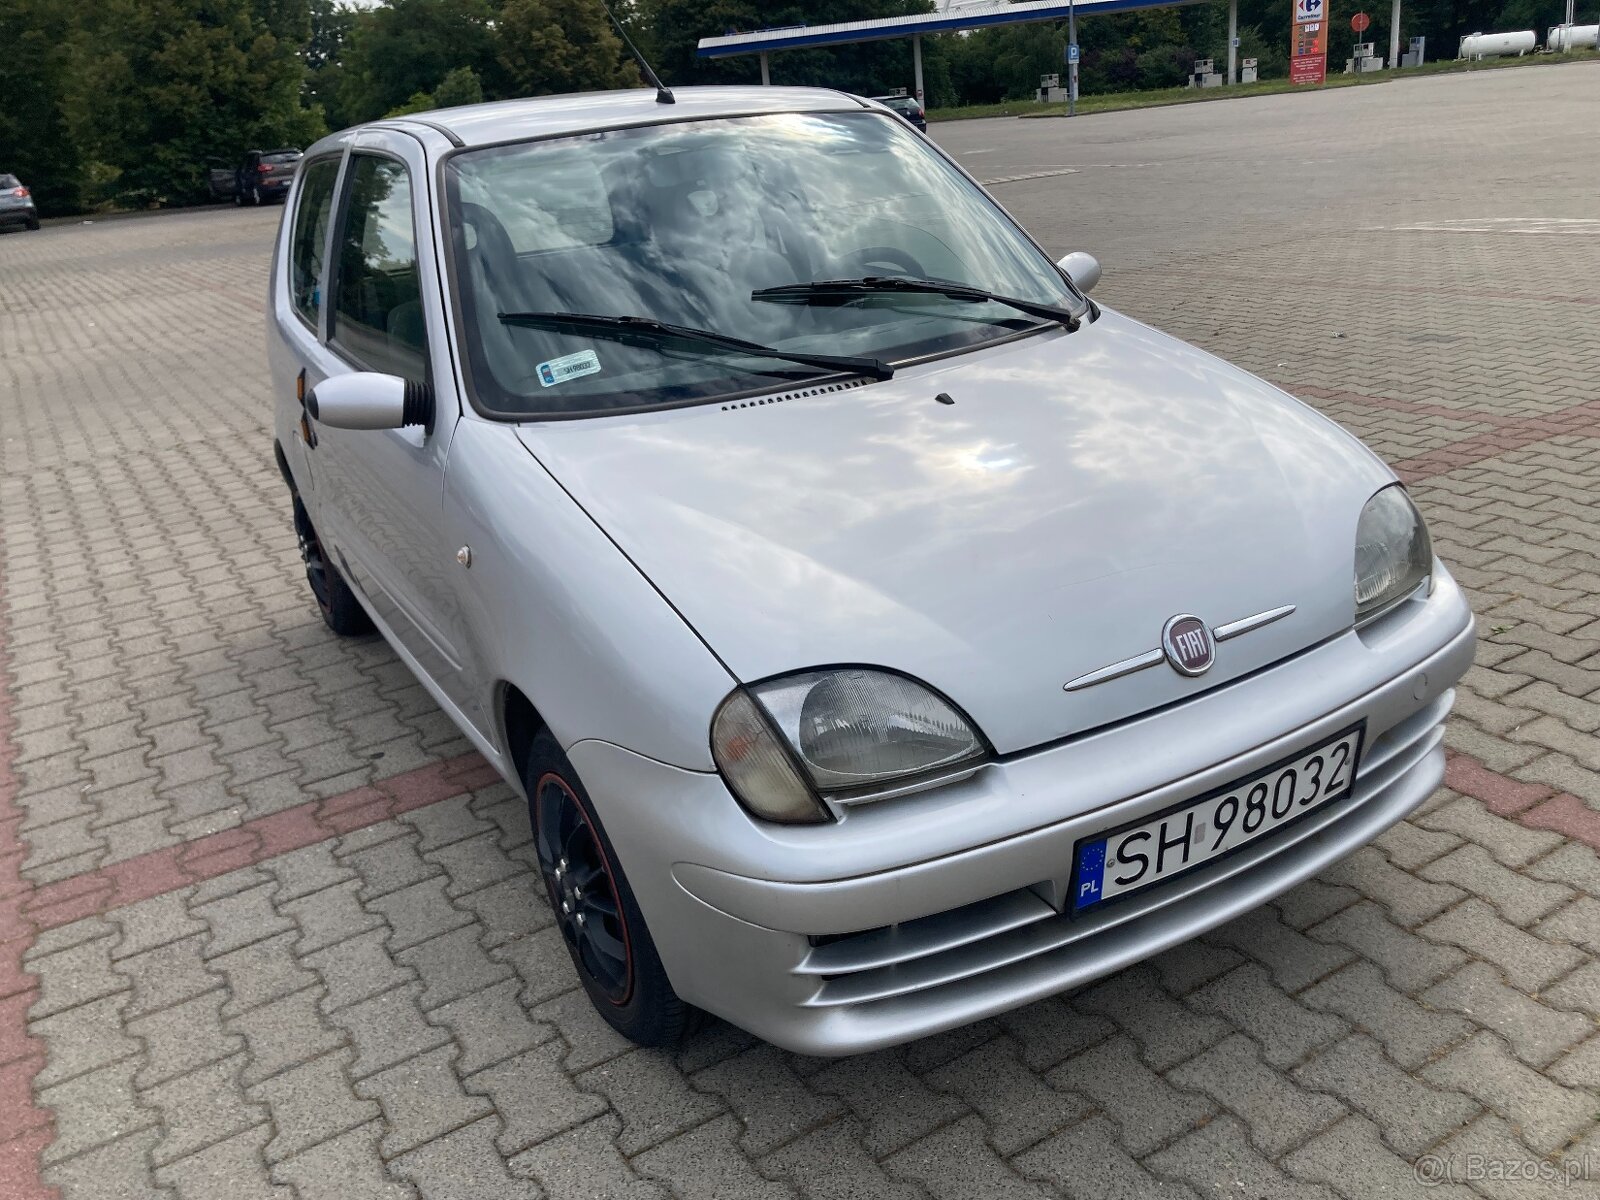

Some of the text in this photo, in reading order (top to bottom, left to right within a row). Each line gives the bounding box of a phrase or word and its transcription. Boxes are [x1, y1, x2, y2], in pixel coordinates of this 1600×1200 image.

[1175, 628, 1207, 661] FIAT
[1114, 741, 1350, 886] SH 98032
[1080, 879, 1099, 897] PL
